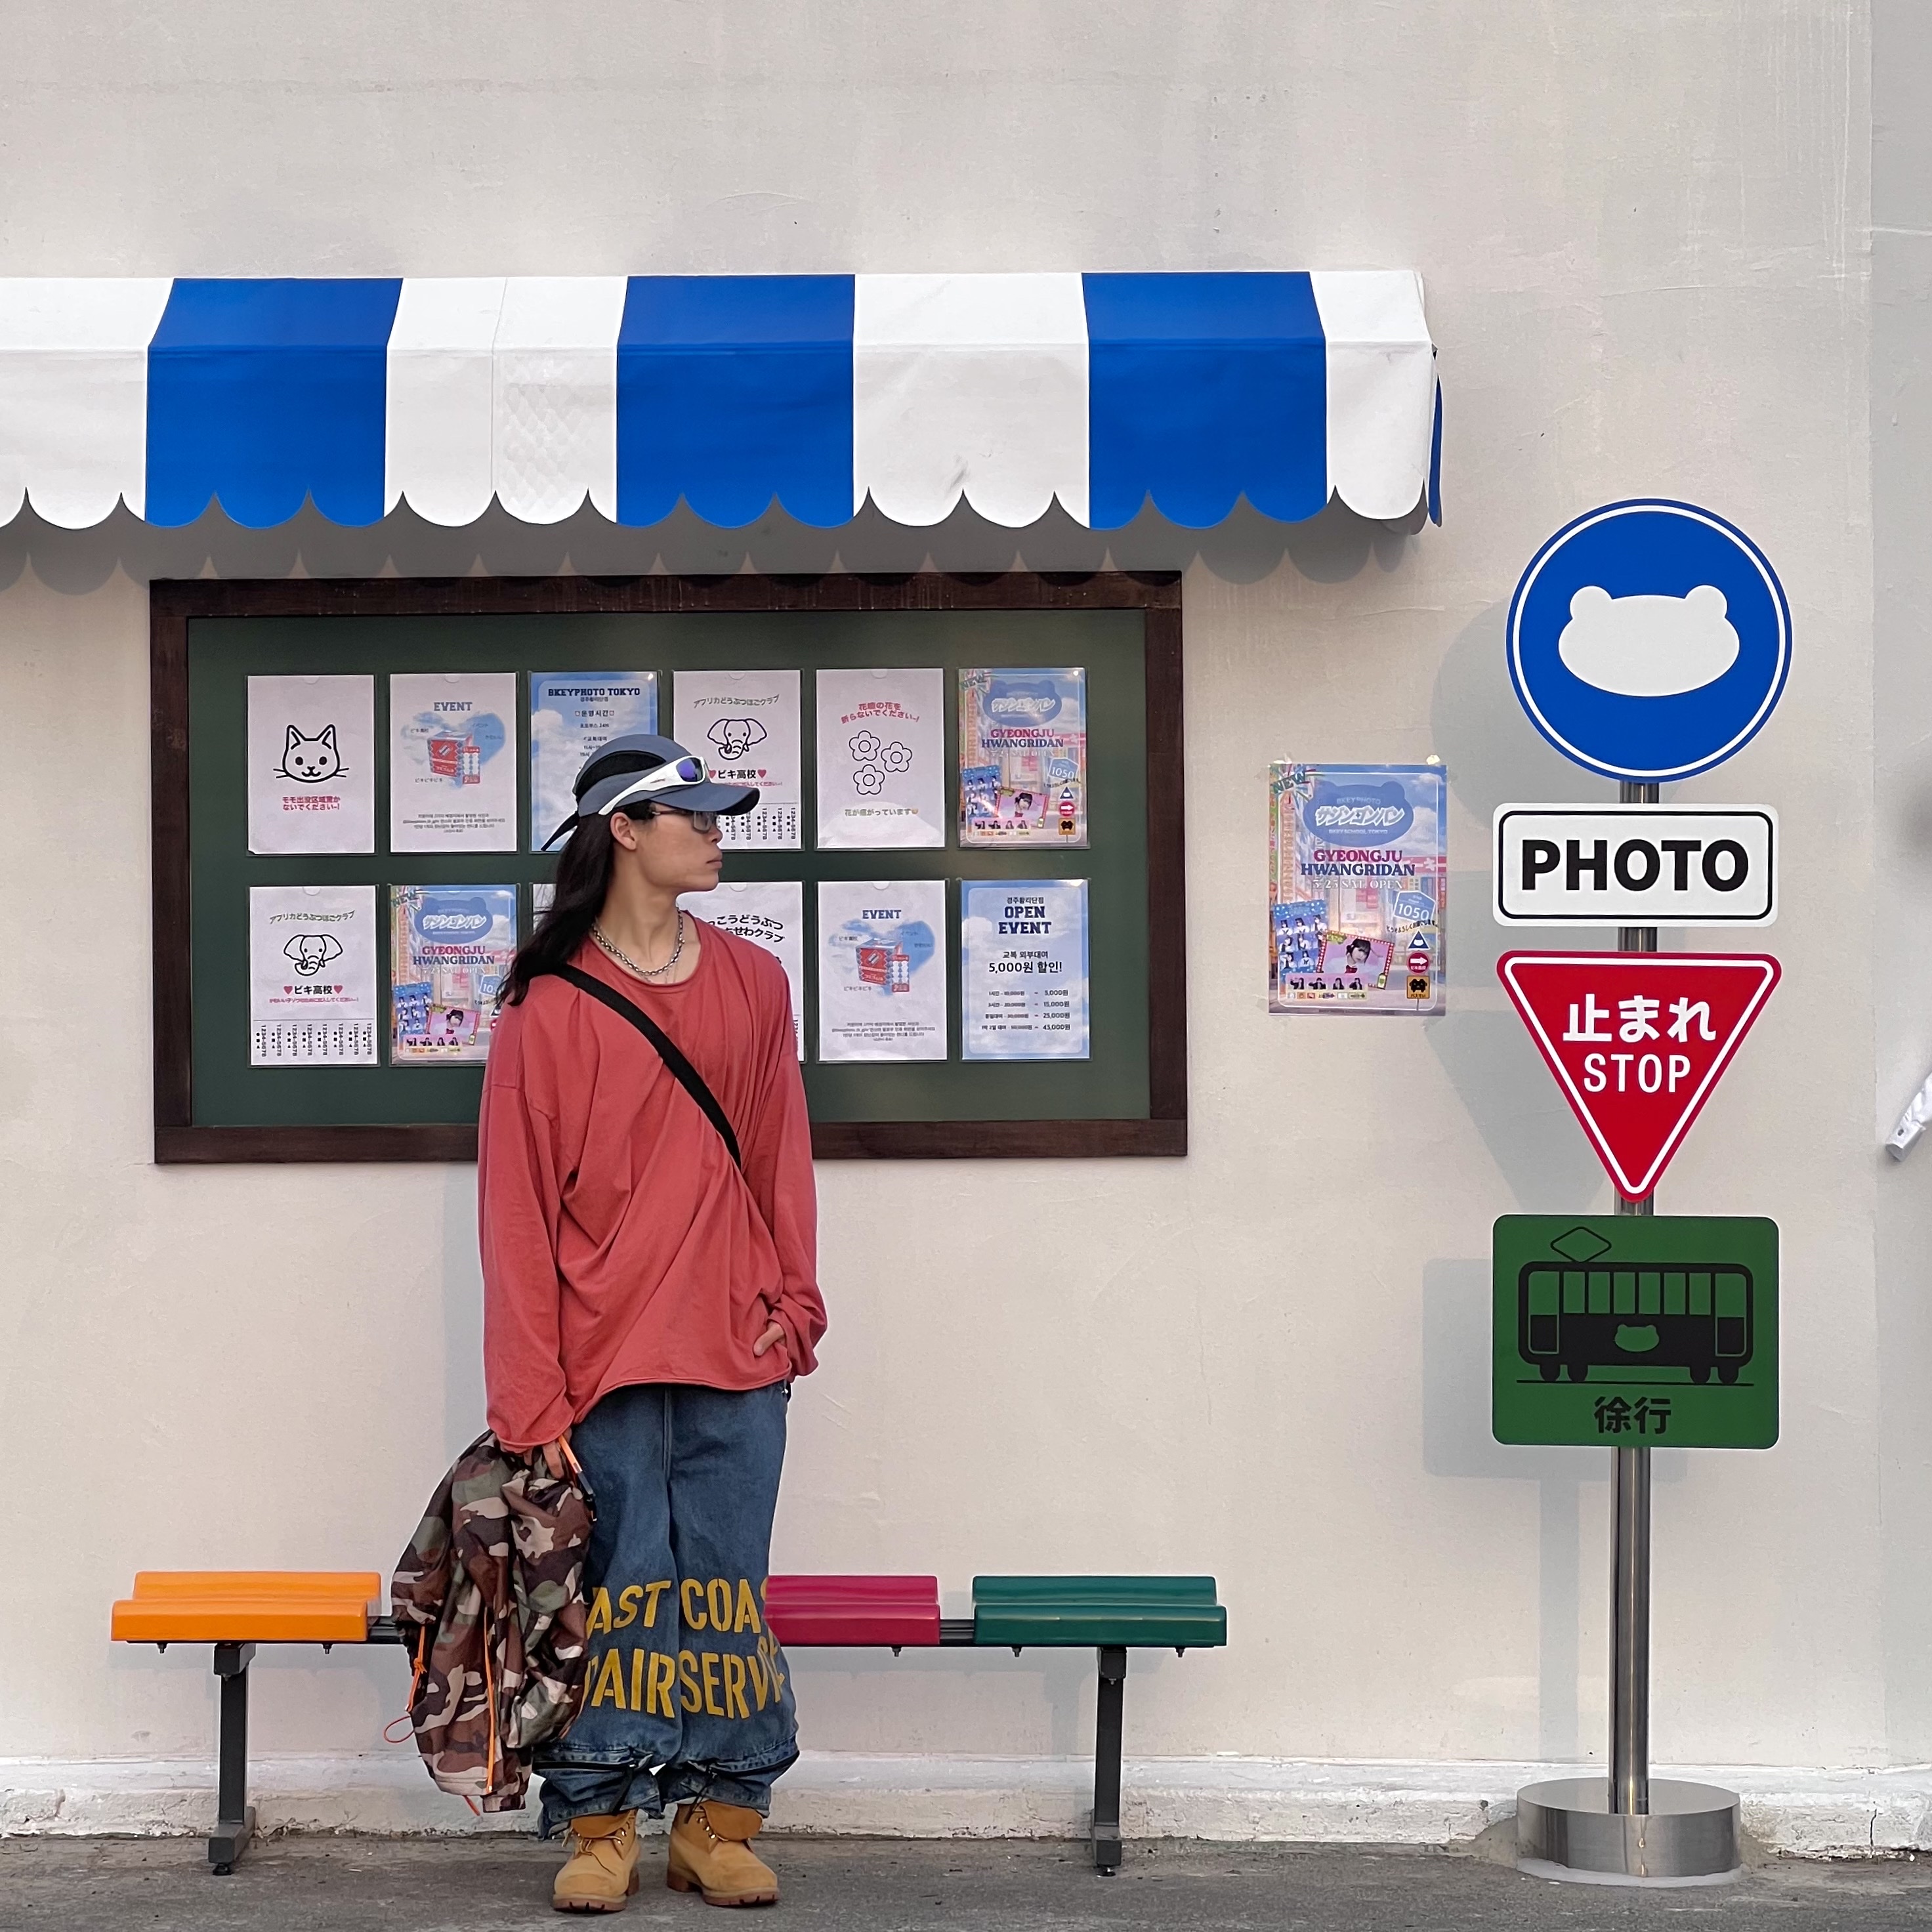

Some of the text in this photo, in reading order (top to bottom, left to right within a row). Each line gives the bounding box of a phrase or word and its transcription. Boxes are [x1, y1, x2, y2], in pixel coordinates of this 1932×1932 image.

[434, 702, 472, 711] EVENT
[991, 729, 1054, 738] GYEONGJU
[982, 739, 1064, 748] HWANGRIDAN
[1052, 766, 1074, 779] 1050
[1314, 850, 1402, 862] GYEONGJU
[1301, 864, 1415, 875] HWANGRIDAN
[1522, 839, 1749, 892] PHOTO
[862, 910, 901, 919] EVENT
[1004, 906, 1045, 918] OPEN
[1398, 903, 1429, 920] 1050
[998, 921, 1051, 934] EVENT
[422, 946, 486, 955] GYEONGJU
[413, 956, 494, 965] HWANGRIDAN
[989, 961, 1062, 974] 5,000원 할인!
[1563, 994, 1717, 1043] 止まれ
[1584, 1053, 1691, 1093] STOP
[1594, 1396, 1671, 1434] 徐行
[586, 1577, 768, 1641] AST COA
